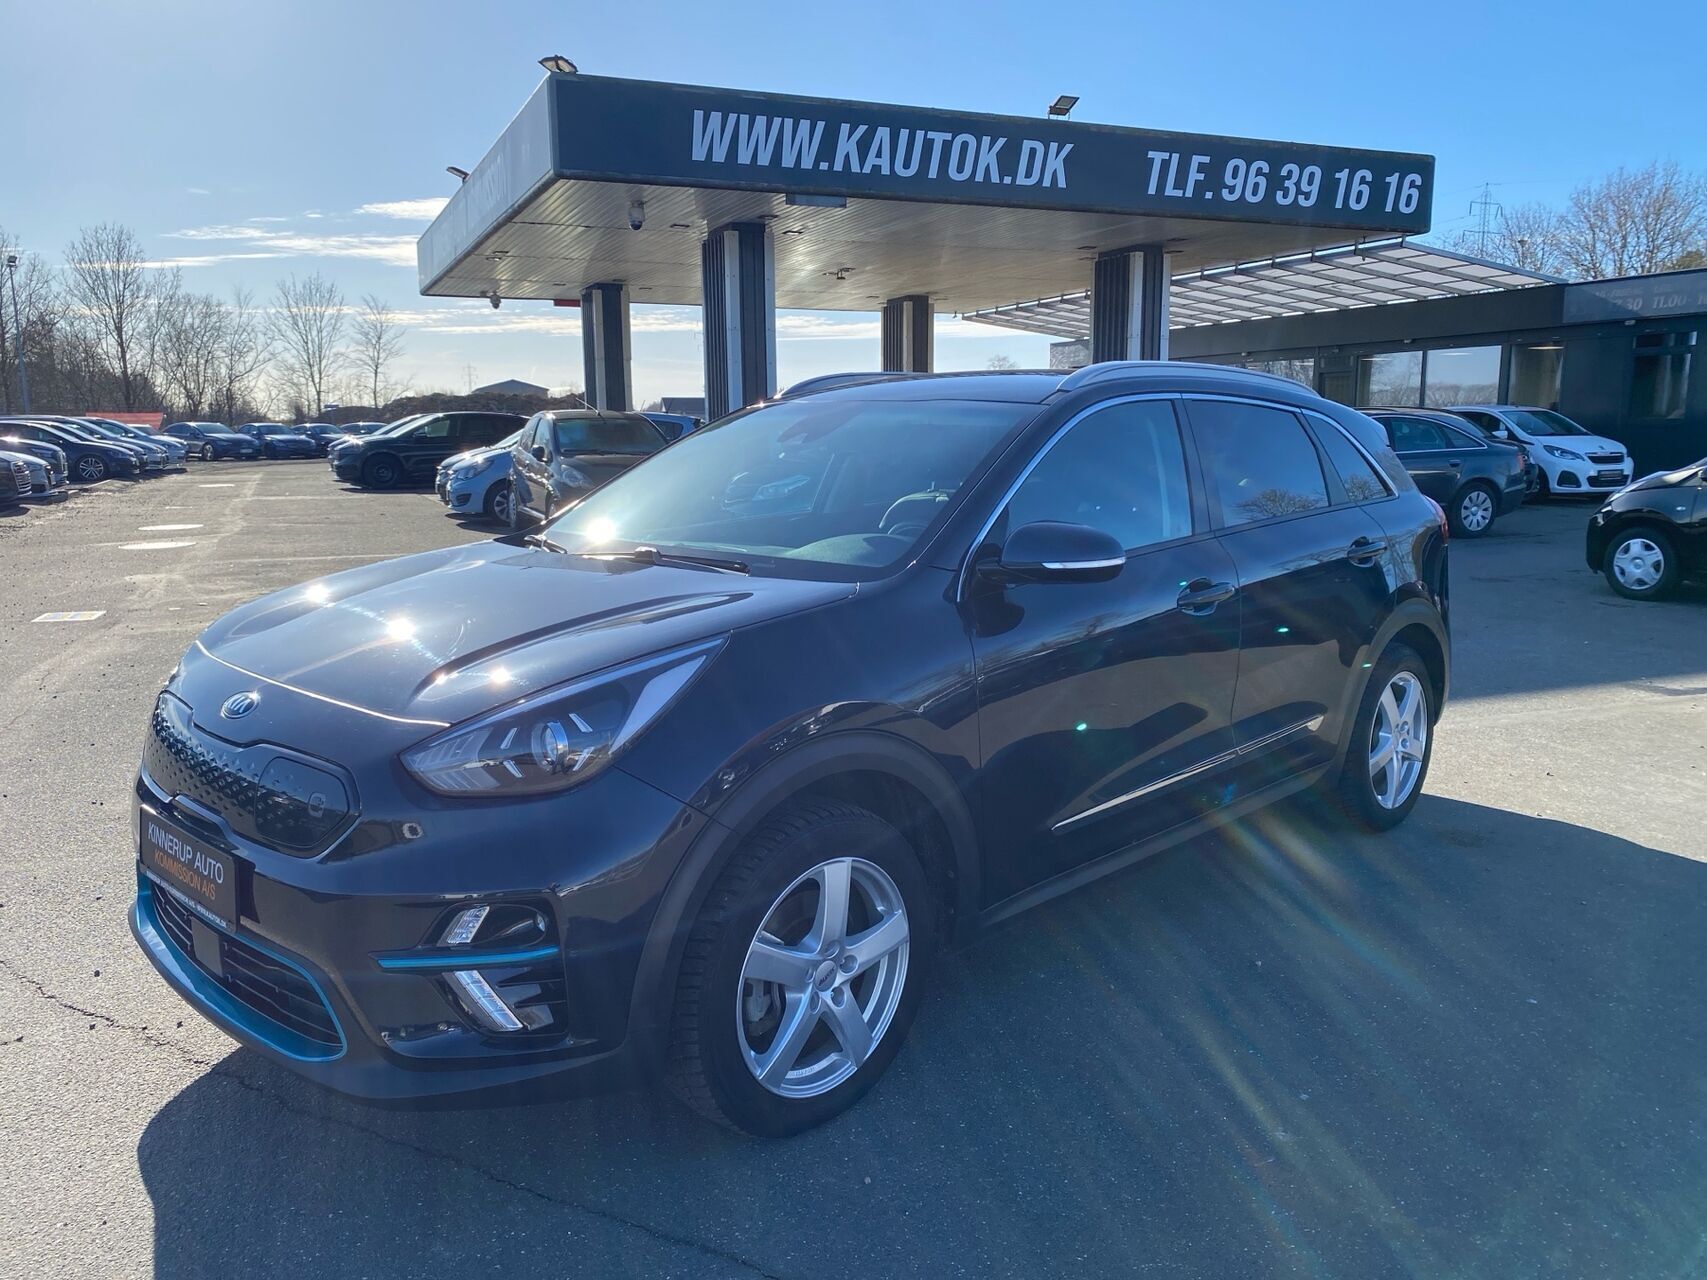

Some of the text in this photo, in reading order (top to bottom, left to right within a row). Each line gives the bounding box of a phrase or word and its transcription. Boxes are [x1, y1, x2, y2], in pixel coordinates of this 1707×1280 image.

[691, 109, 1074, 189] WWW.KAUTOK.DK
[1147, 151, 1422, 214] TLF. 96 39 16 16
[148, 821, 224, 884] KINNERUP AUTO
[154, 850, 200, 890] KOMMISSION
[201, 879, 216, 900] A/S
